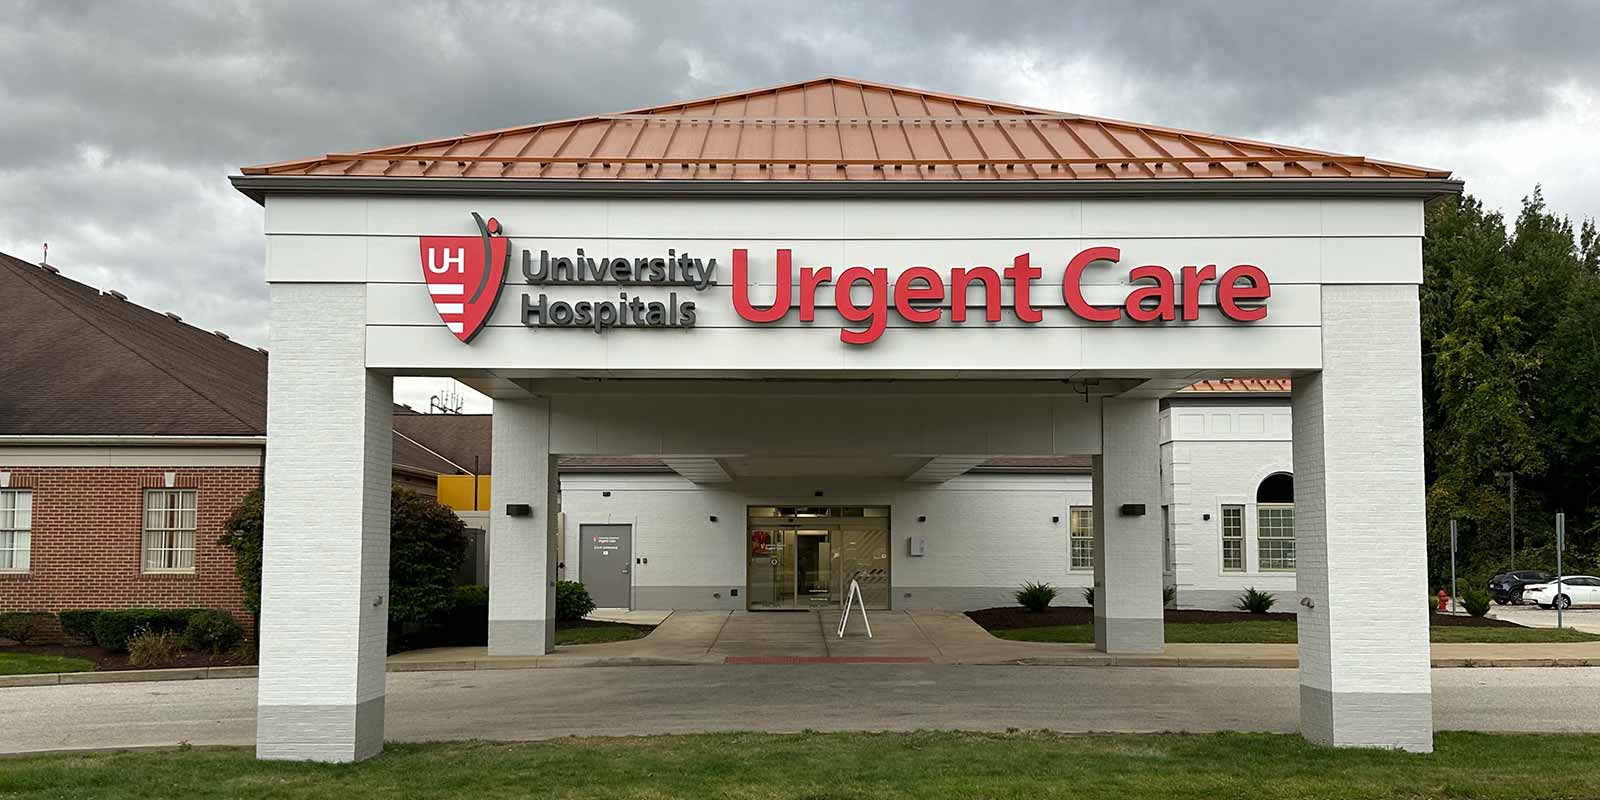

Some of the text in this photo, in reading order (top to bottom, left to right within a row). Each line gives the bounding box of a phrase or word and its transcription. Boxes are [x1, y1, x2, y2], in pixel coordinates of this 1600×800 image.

[428, 248, 465, 273] UH
[522, 248, 717, 291] University
[521, 292, 697, 334] Hospitals
[732, 246, 1271, 345] Urgent Care
